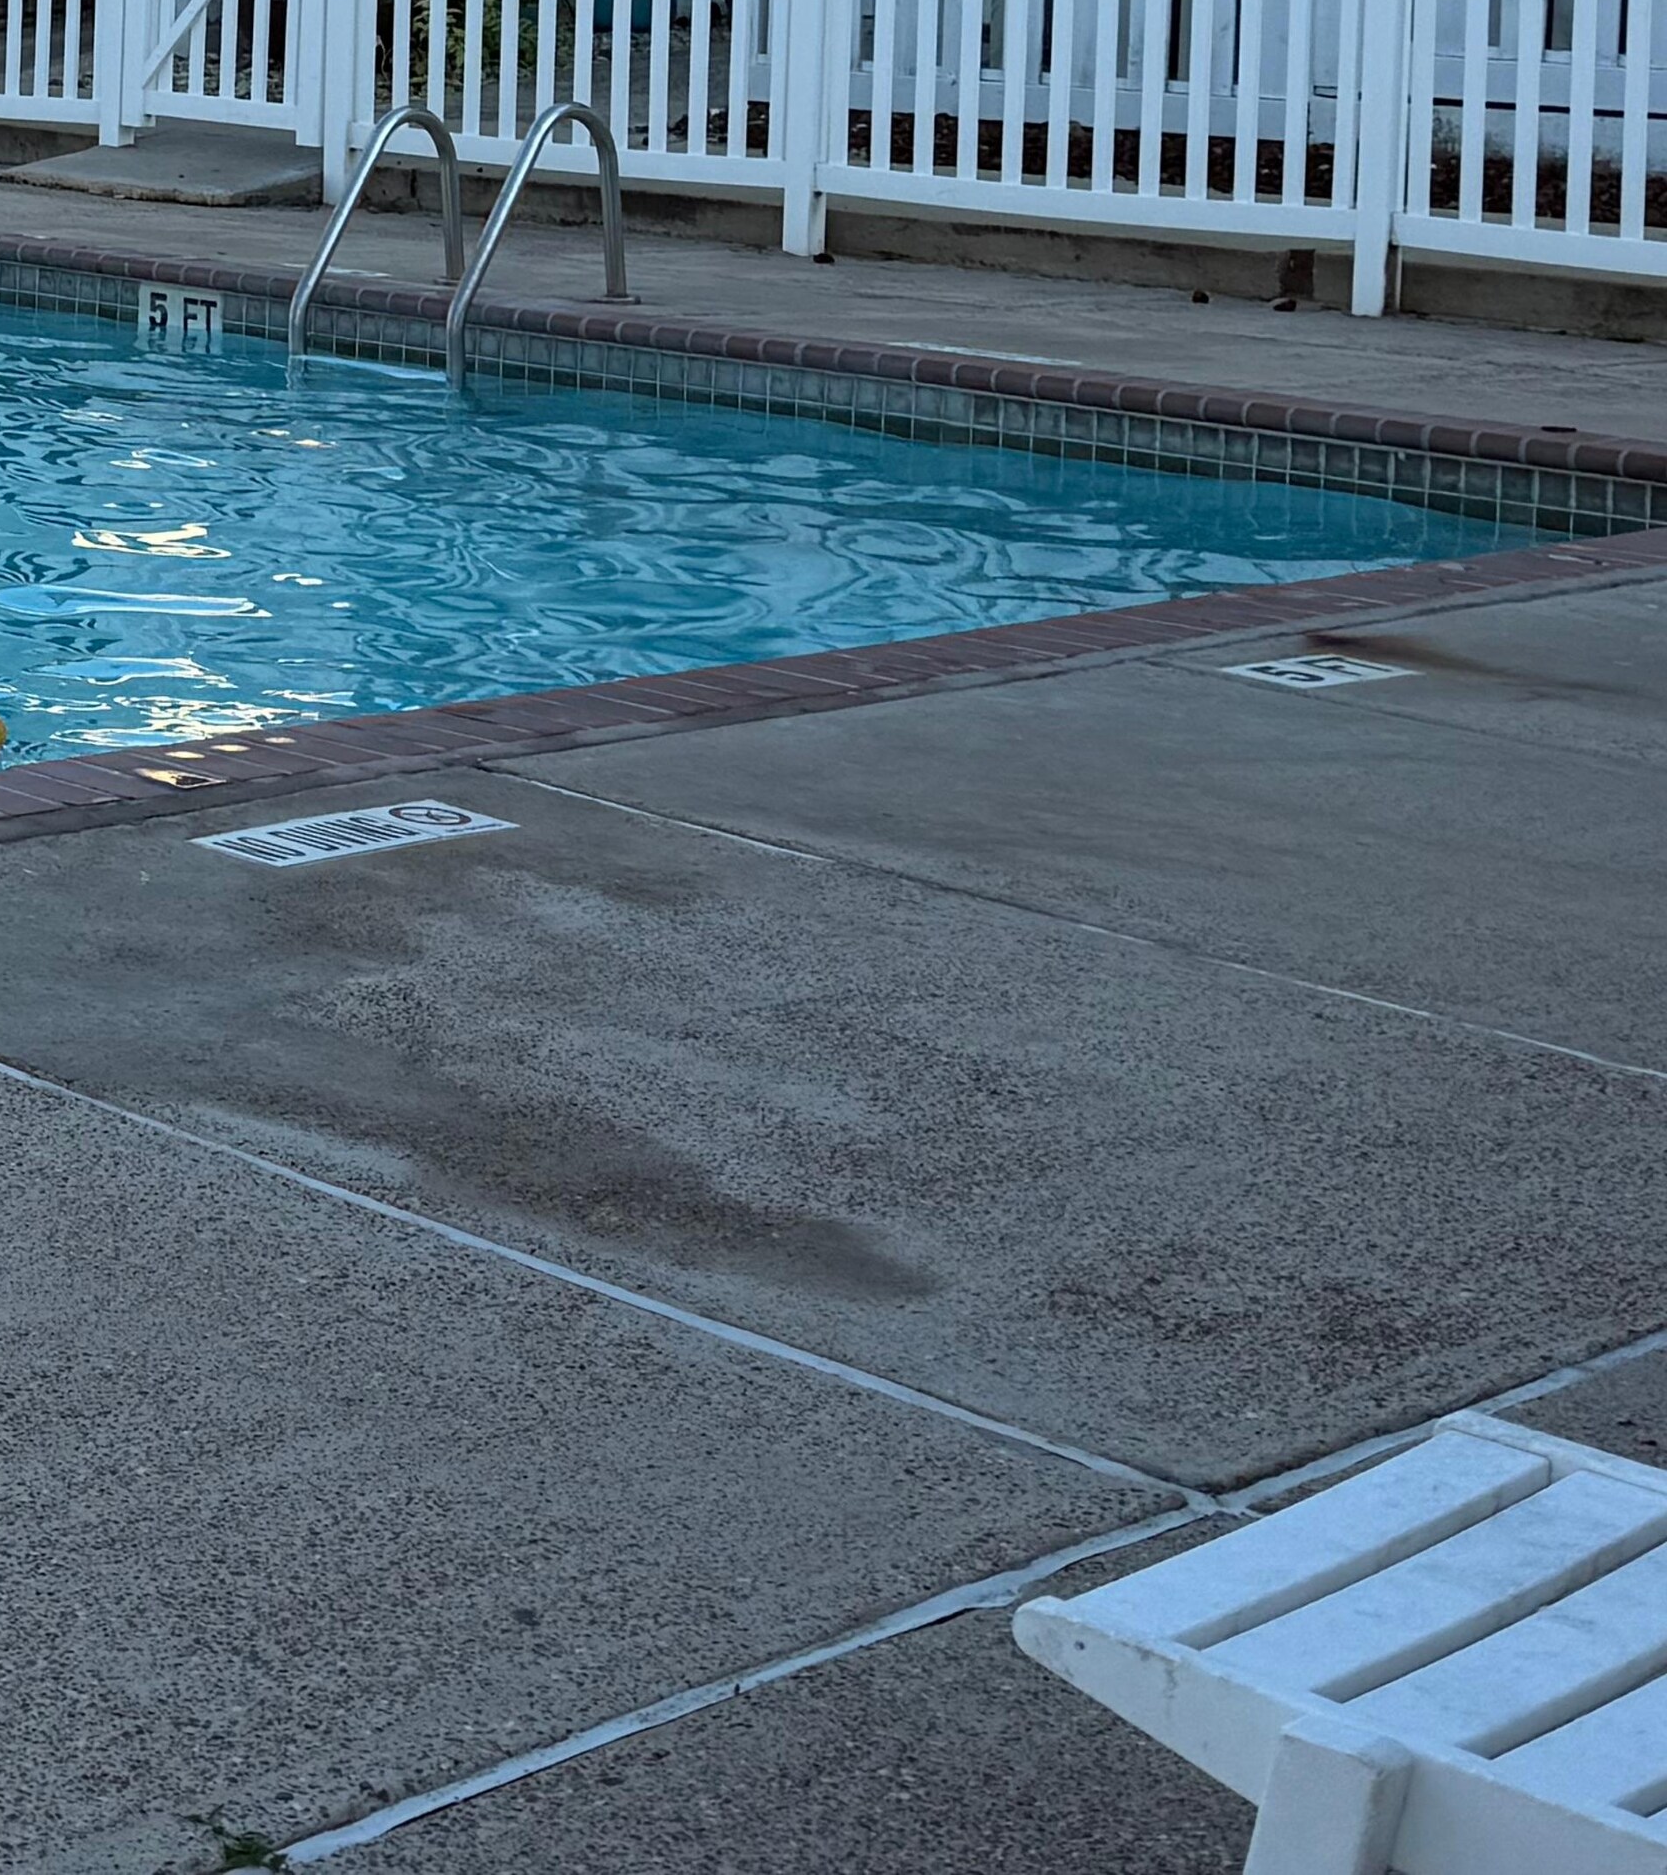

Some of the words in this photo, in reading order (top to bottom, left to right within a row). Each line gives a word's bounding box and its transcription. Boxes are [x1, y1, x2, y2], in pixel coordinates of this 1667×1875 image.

[149, 292, 168, 331] 5
[182, 297, 218, 342] FT
[1246, 665, 1325, 682] 5
[1293, 656, 1394, 676] FT
[213, 836, 307, 863] NO
[269, 816, 420, 852] DIVING
